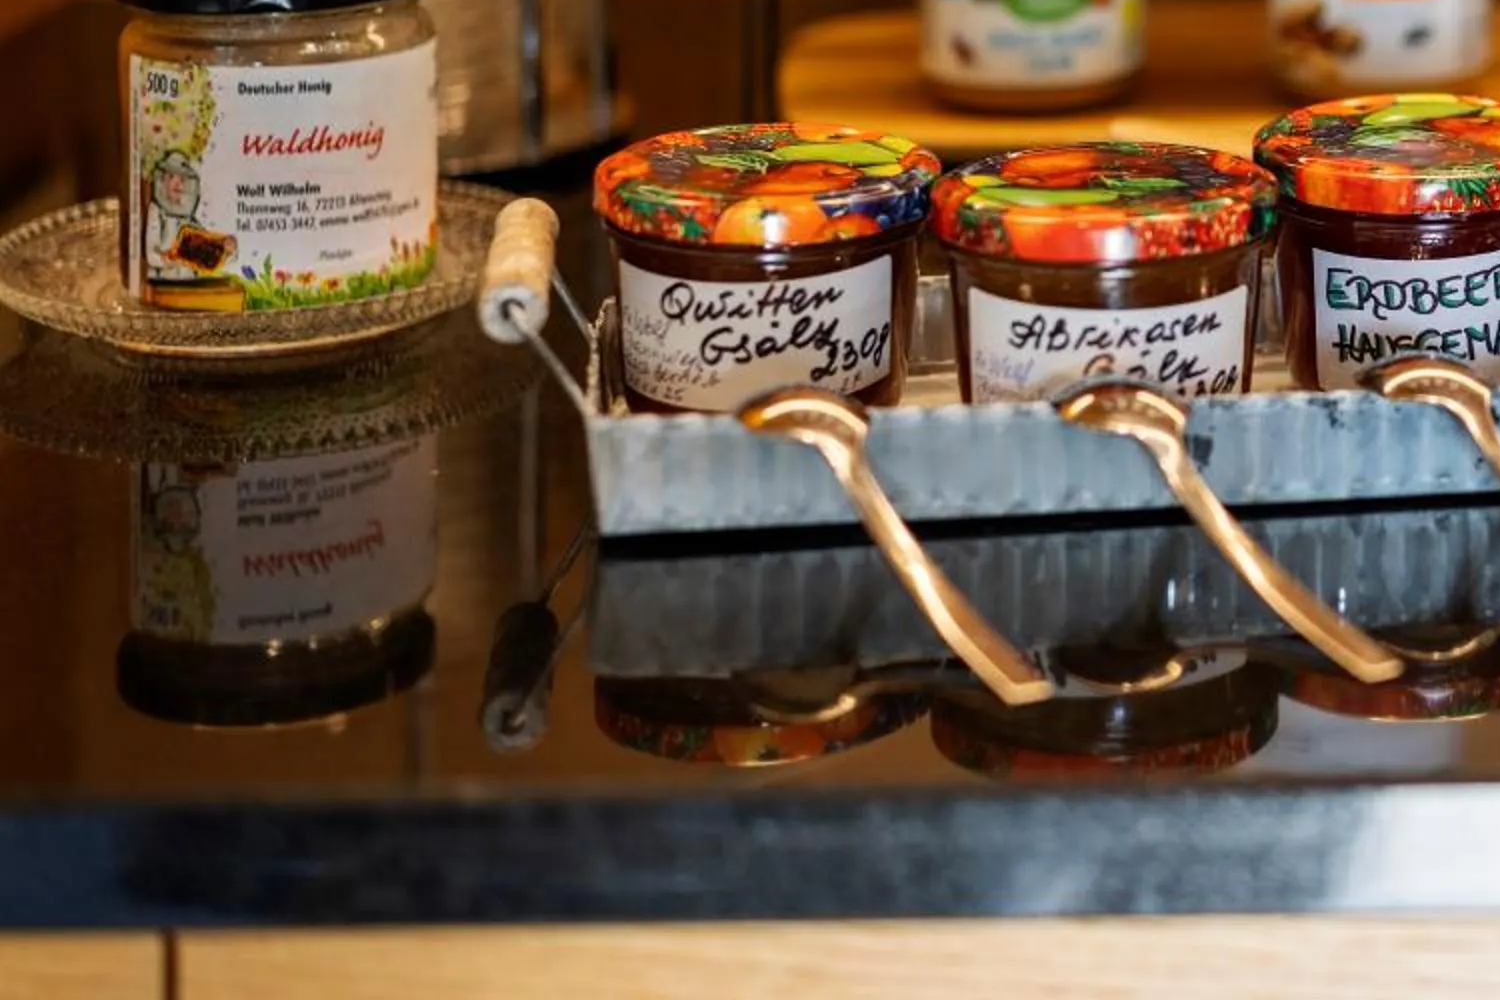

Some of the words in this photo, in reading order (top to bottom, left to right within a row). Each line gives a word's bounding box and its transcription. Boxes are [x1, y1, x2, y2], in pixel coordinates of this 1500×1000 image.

[237, 82, 294, 95] Deutscher
[298, 80, 332, 95] Honig
[241, 120, 384, 160] Waldhonig
[237, 185, 265, 197] Wolf
[268, 182, 321, 197] Wilhelm
